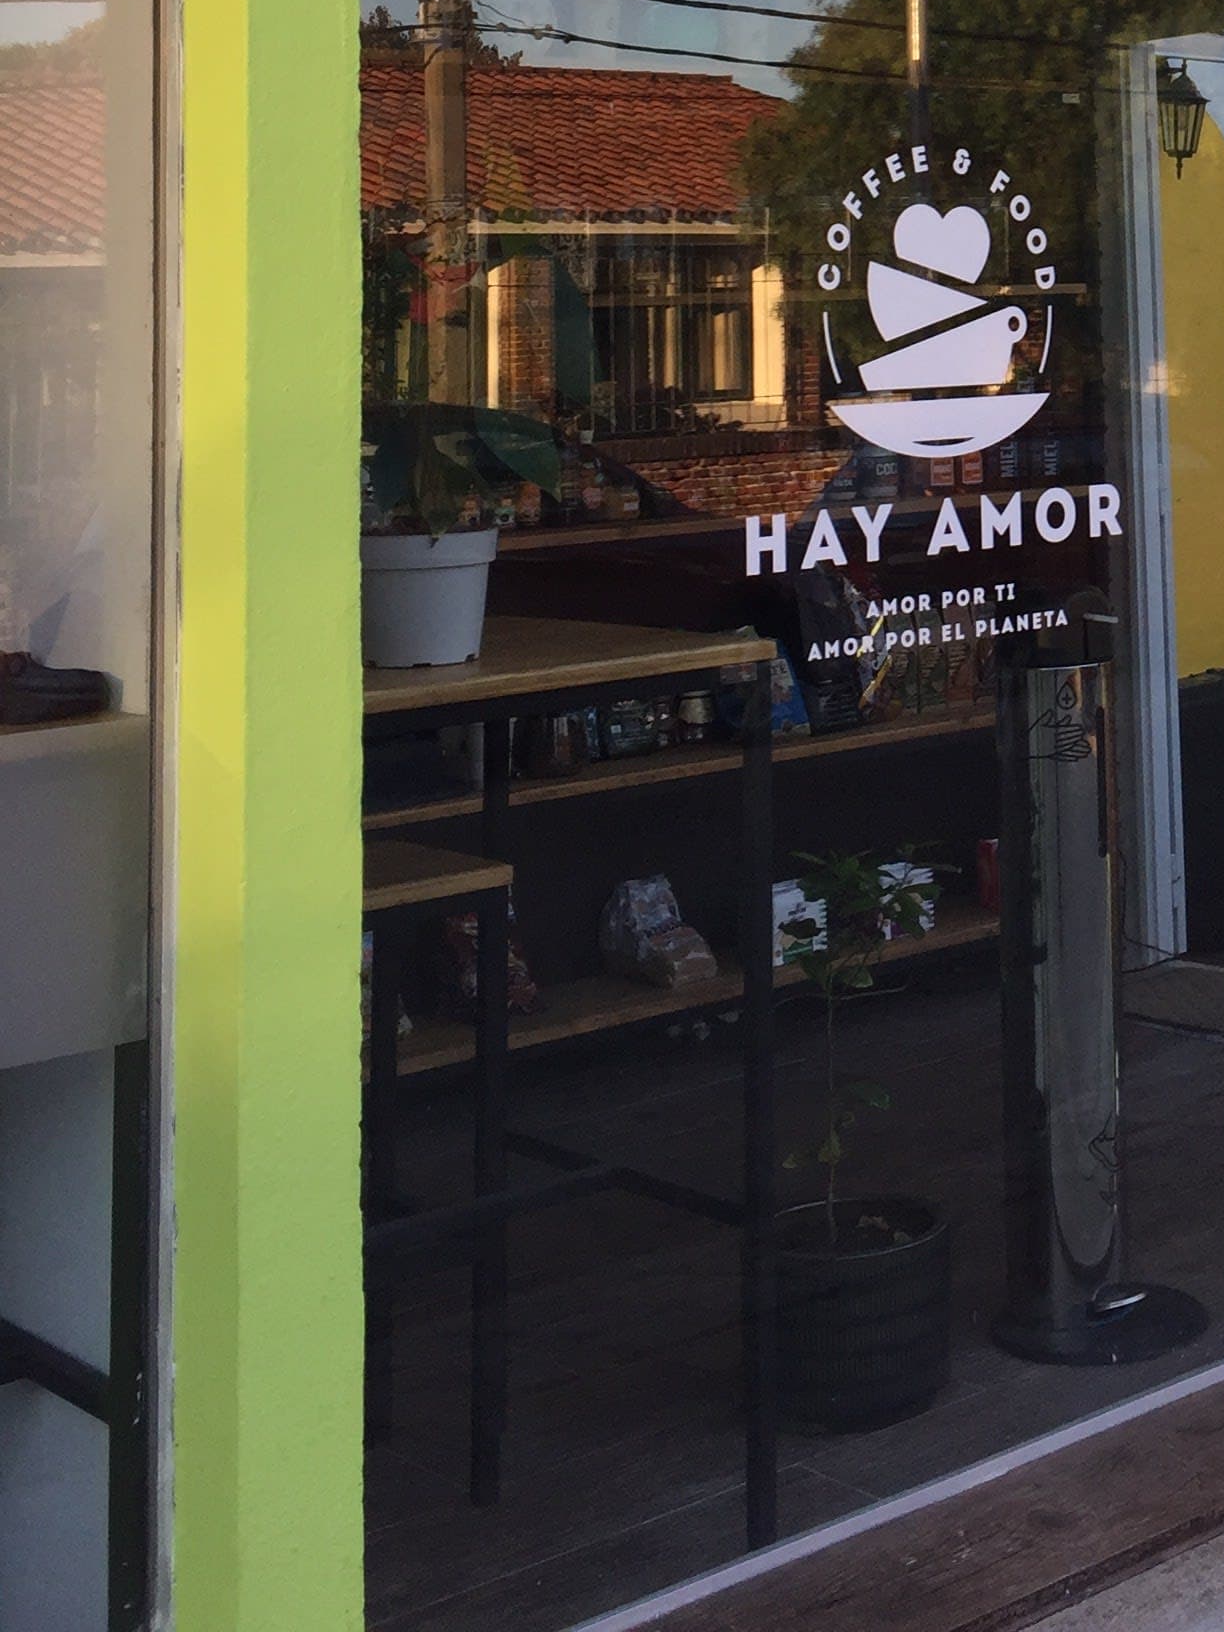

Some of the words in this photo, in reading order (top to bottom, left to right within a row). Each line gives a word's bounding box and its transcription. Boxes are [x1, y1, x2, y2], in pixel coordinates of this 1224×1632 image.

[817, 144, 930, 292] COFFEE
[951, 147, 972, 176] &
[989, 168, 1056, 290] FOOD
[1000, 441, 1016, 478] MIEL
[1043, 440, 1058, 477] MIEL
[745, 503, 894, 577] HAY
[926, 483, 1124, 556] AMOR
[865, 594, 931, 619] AMOR
[941, 587, 986, 609] POR
[994, 583, 1016, 602] TI
[807, 635, 875, 662] AMOR
[885, 627, 931, 651] POR
[941, 623, 965, 643] EL
[975, 609, 1069, 638] PLANETA
